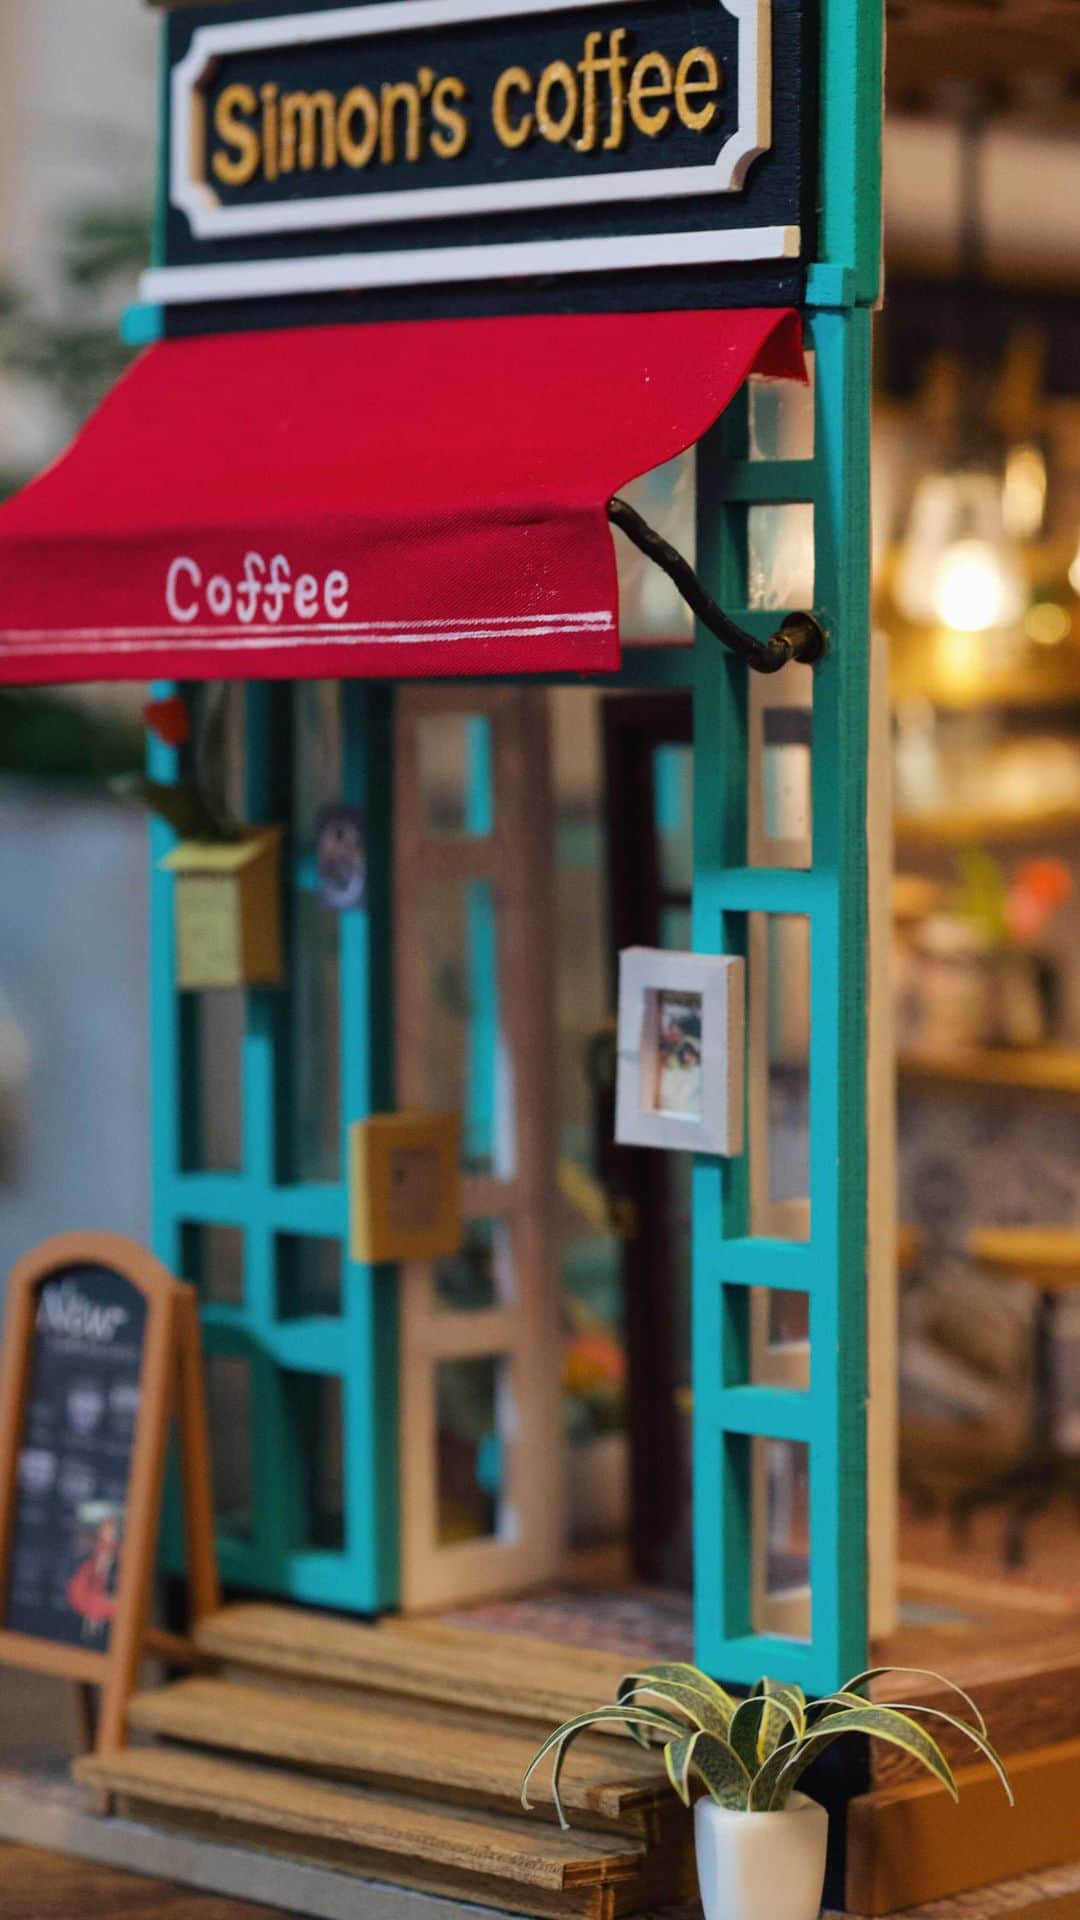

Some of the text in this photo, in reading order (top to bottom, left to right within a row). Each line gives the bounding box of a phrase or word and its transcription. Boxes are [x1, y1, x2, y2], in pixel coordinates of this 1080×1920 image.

[212, 28, 720, 187] Simon's coffee
[165, 551, 349, 623] Coffee
